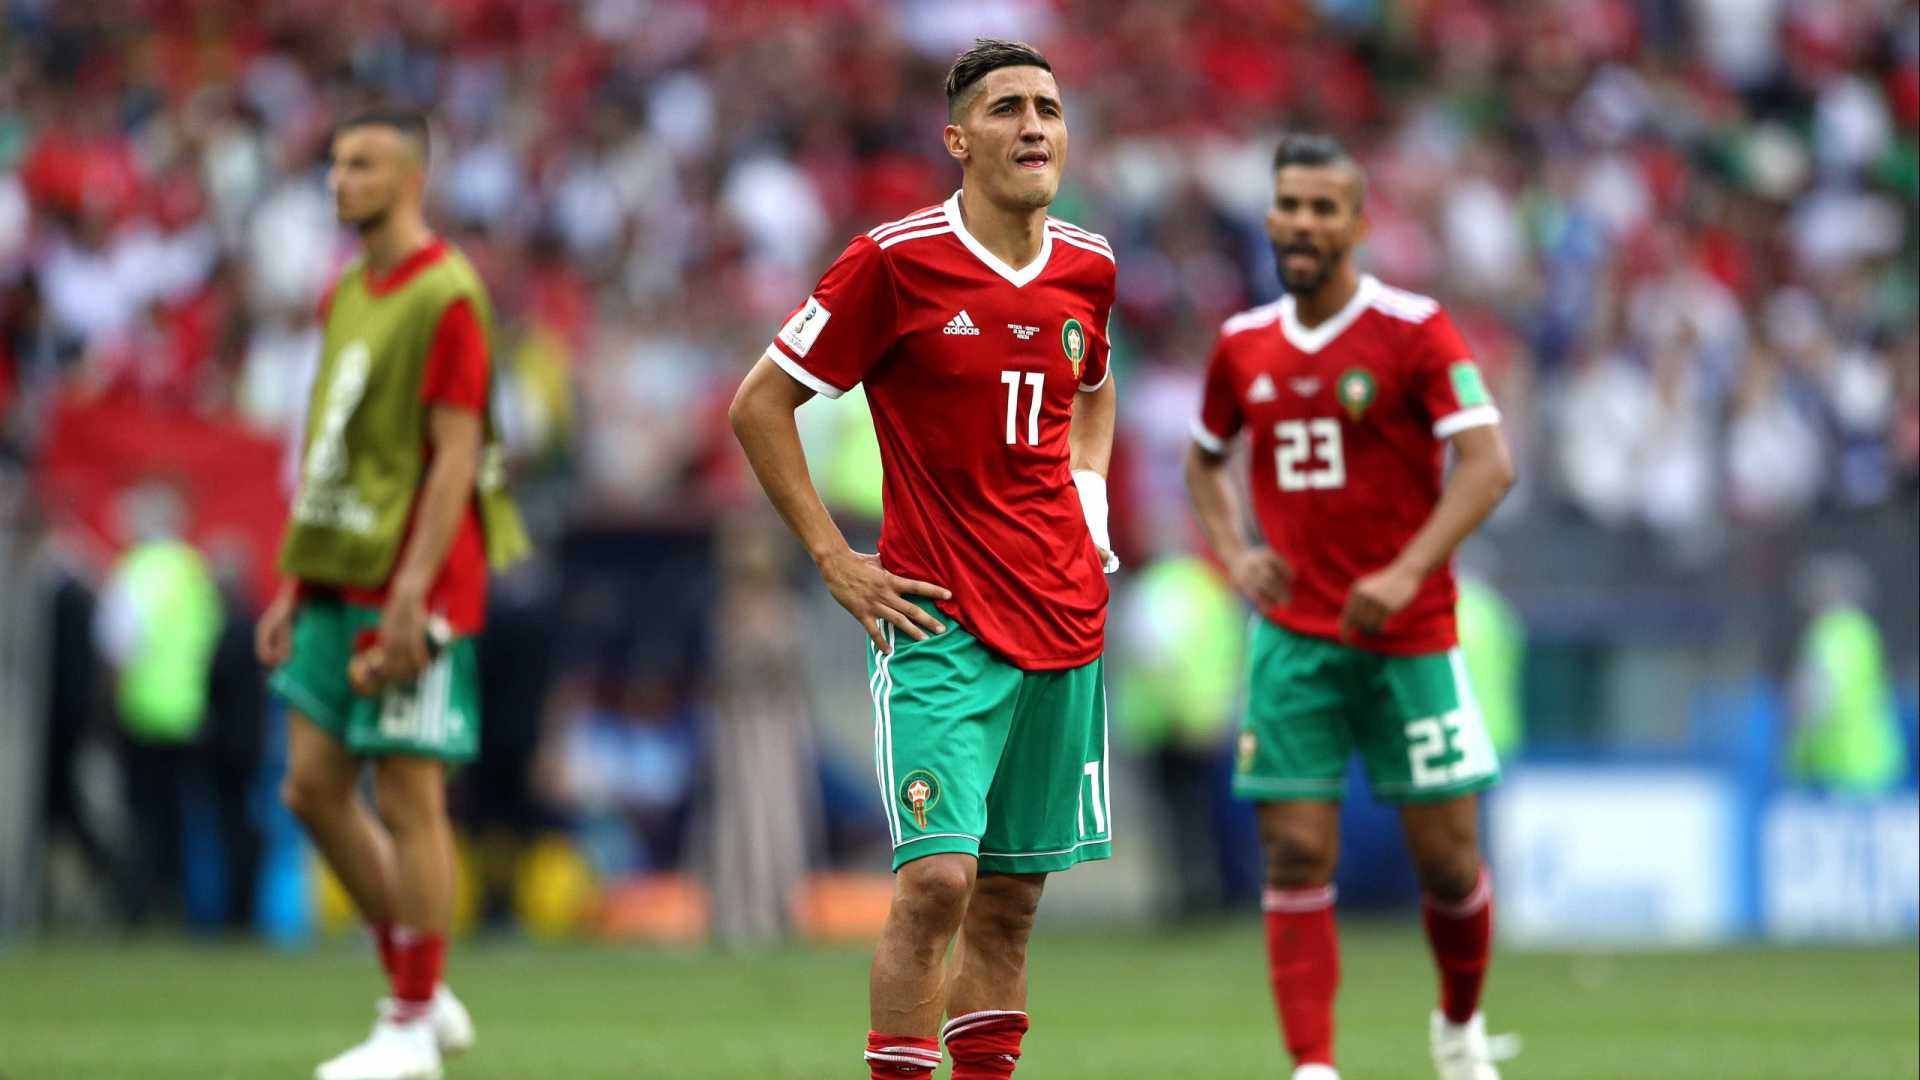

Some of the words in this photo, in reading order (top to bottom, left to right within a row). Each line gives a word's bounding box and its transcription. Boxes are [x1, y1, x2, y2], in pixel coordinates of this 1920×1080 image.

[943, 326, 980, 336] adidas
[1001, 370, 1045, 446] 11
[1274, 417, 1346, 491] 23
[1405, 709, 1482, 788] 23
